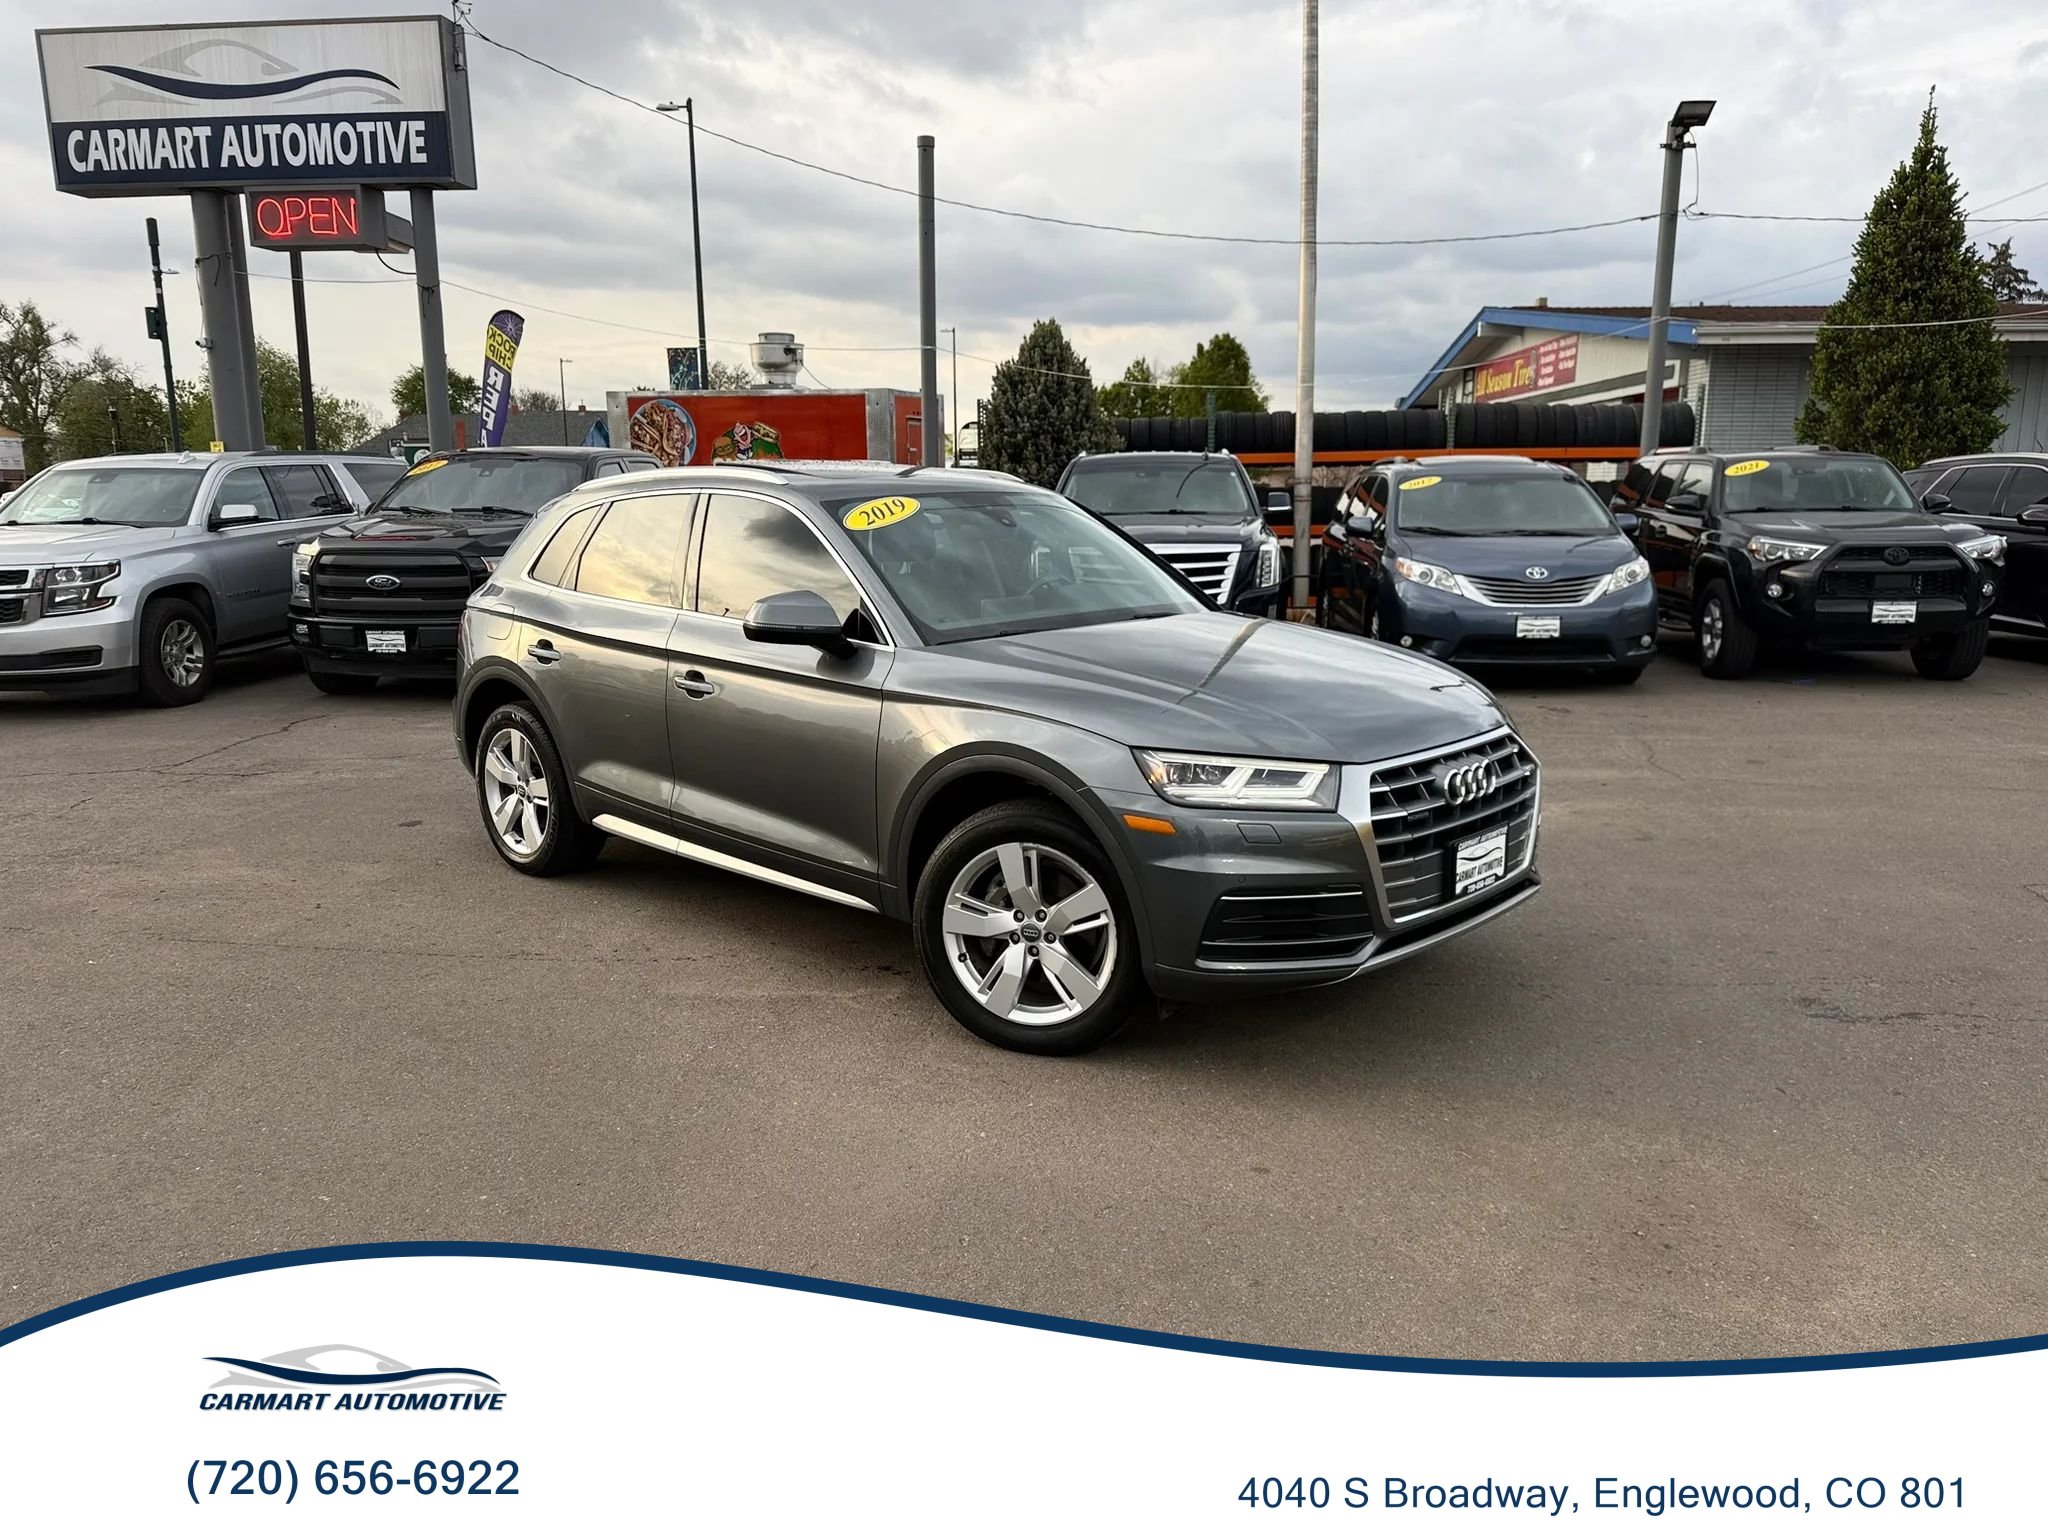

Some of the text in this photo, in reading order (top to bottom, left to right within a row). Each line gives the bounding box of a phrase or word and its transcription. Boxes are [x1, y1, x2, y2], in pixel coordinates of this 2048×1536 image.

[67, 120, 428, 173] CARMART AUTOMOTIVE
[256, 198, 358, 237] OPEN
[1486, 367, 1513, 394] Season
[1733, 461, 1760, 474] 2021
[858, 498, 906, 527] 2019
